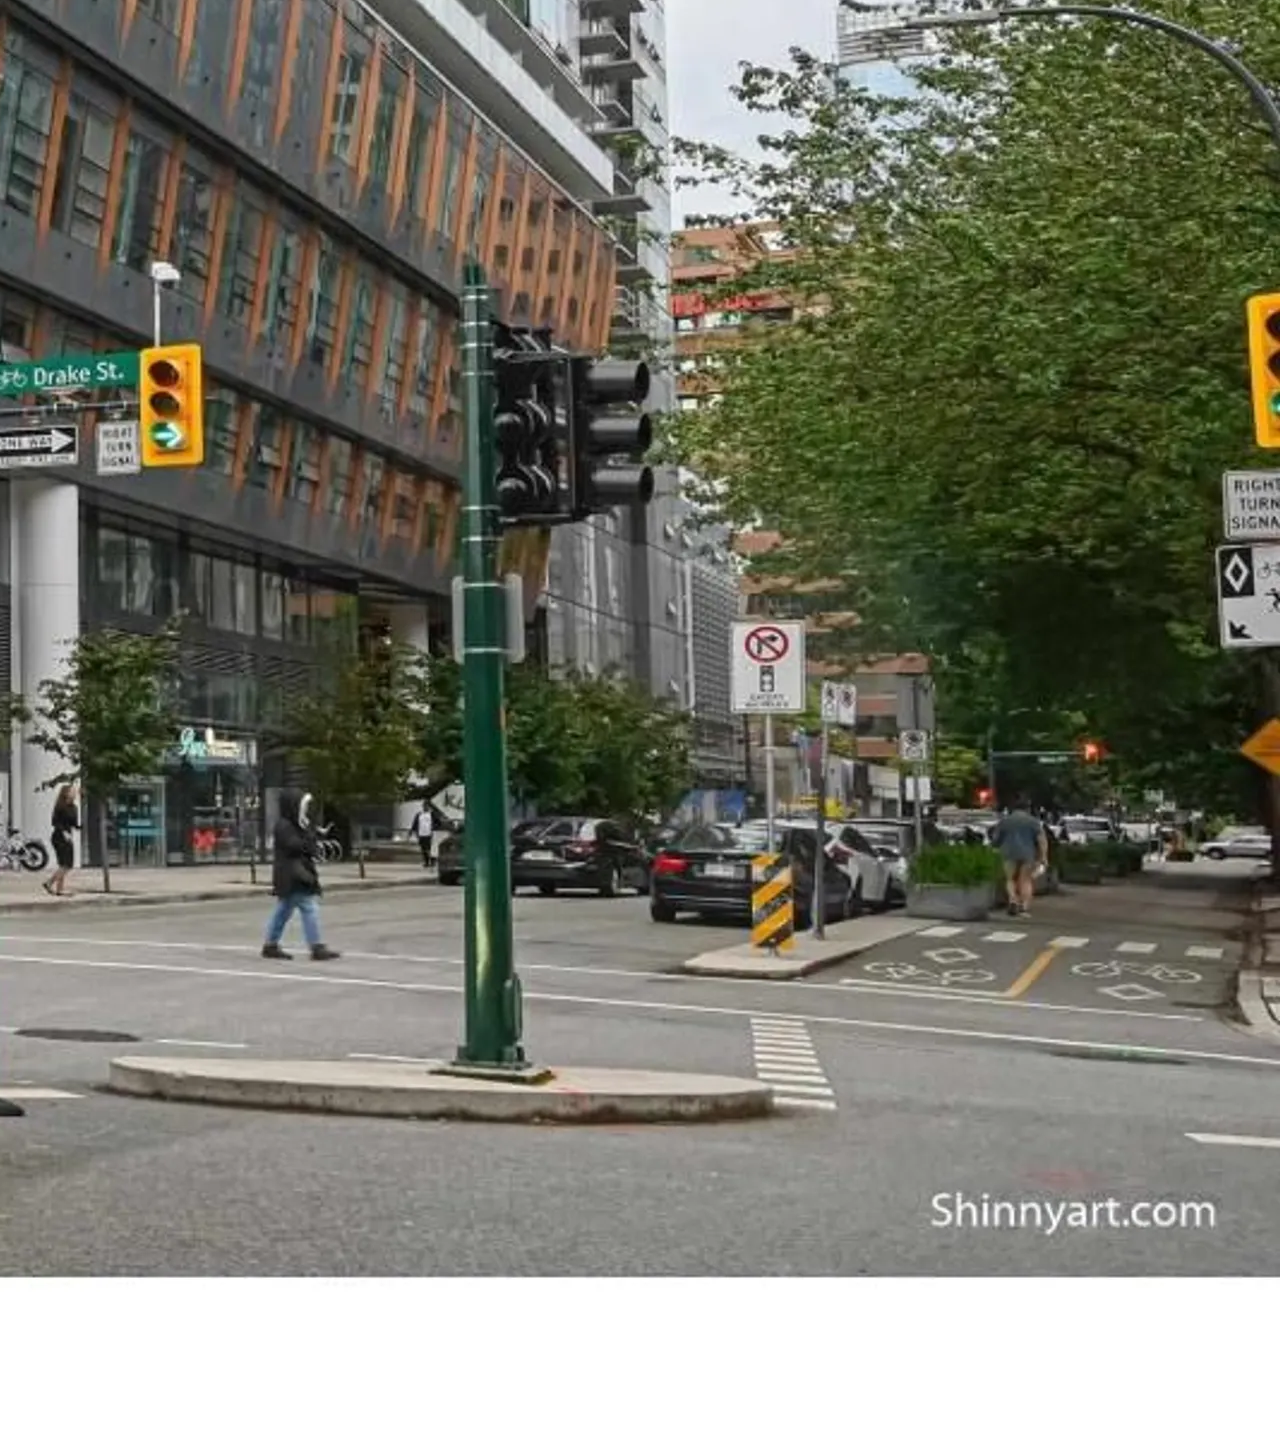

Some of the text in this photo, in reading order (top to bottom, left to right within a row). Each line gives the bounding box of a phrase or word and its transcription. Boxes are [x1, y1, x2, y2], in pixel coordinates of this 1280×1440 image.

[33, 361, 125, 386] Drake St.
[1232, 515, 1280, 529] SIGNA
